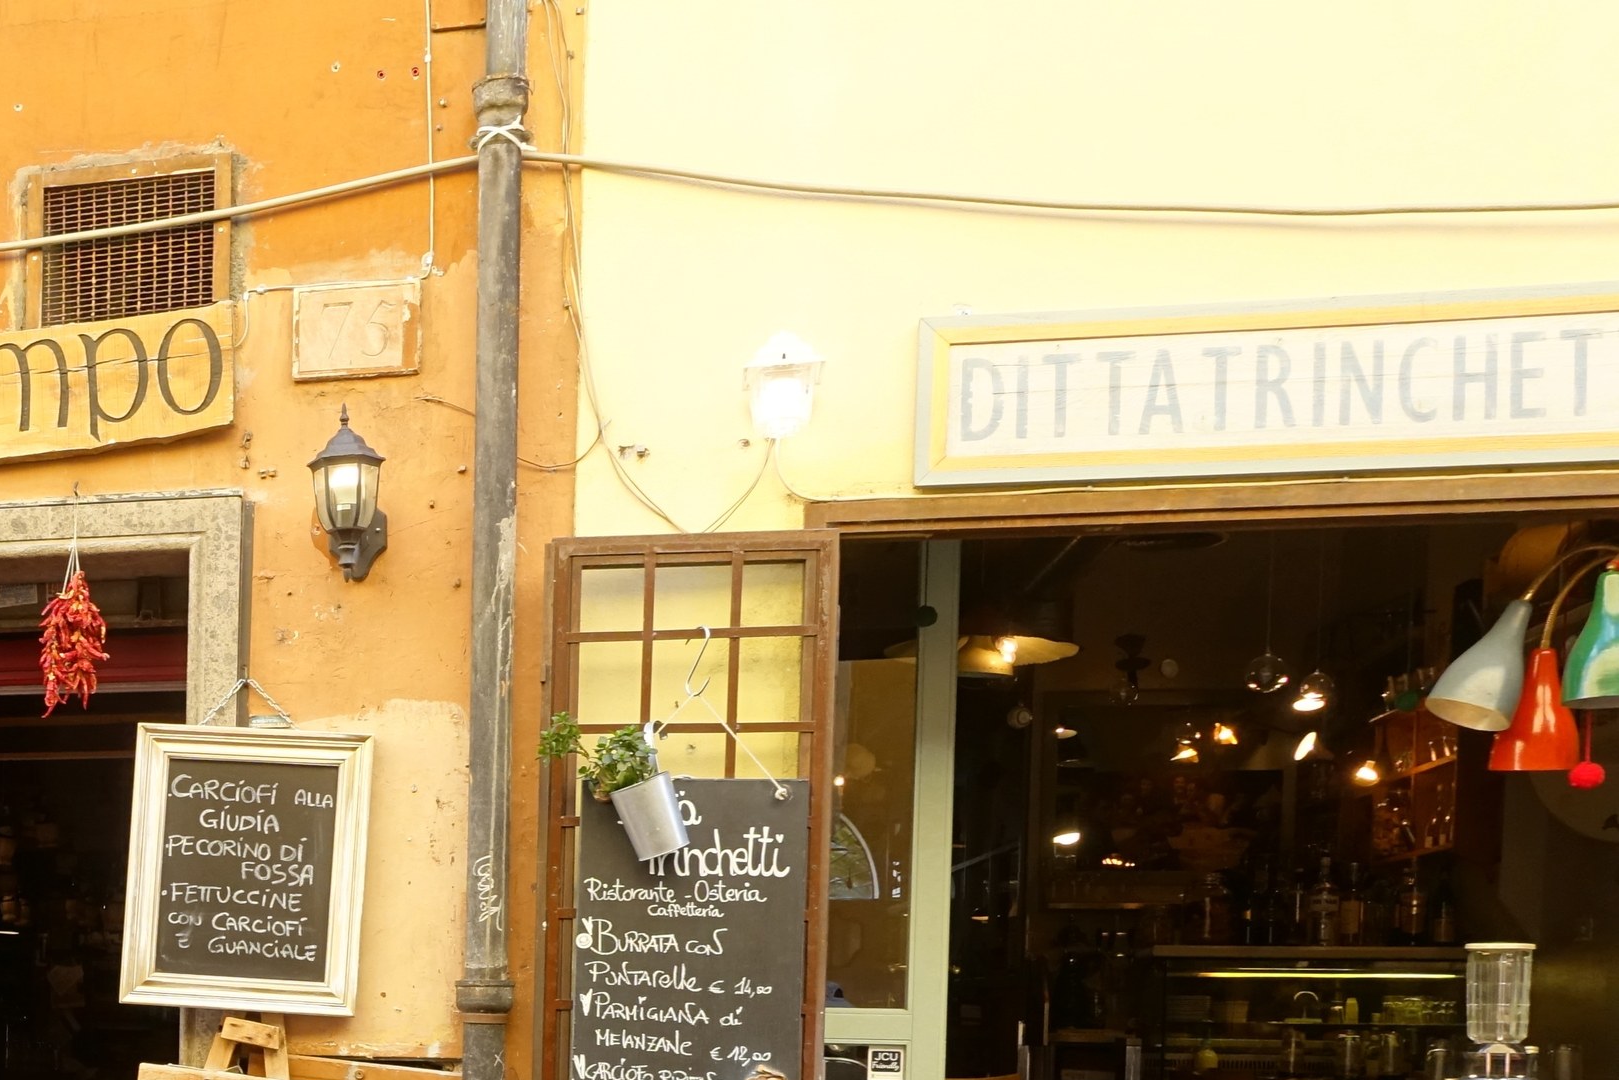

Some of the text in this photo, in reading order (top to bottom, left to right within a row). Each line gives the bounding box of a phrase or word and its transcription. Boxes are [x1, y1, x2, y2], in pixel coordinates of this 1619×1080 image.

[320, 299, 397, 357] 75
[294, 788, 333, 808] ALLA
[241, 861, 314, 887] FOSSA
[584, 877, 677, 902] Ristorante
[590, 918, 680, 956] BURRATA
[874, 1052, 899, 1061] JCU
